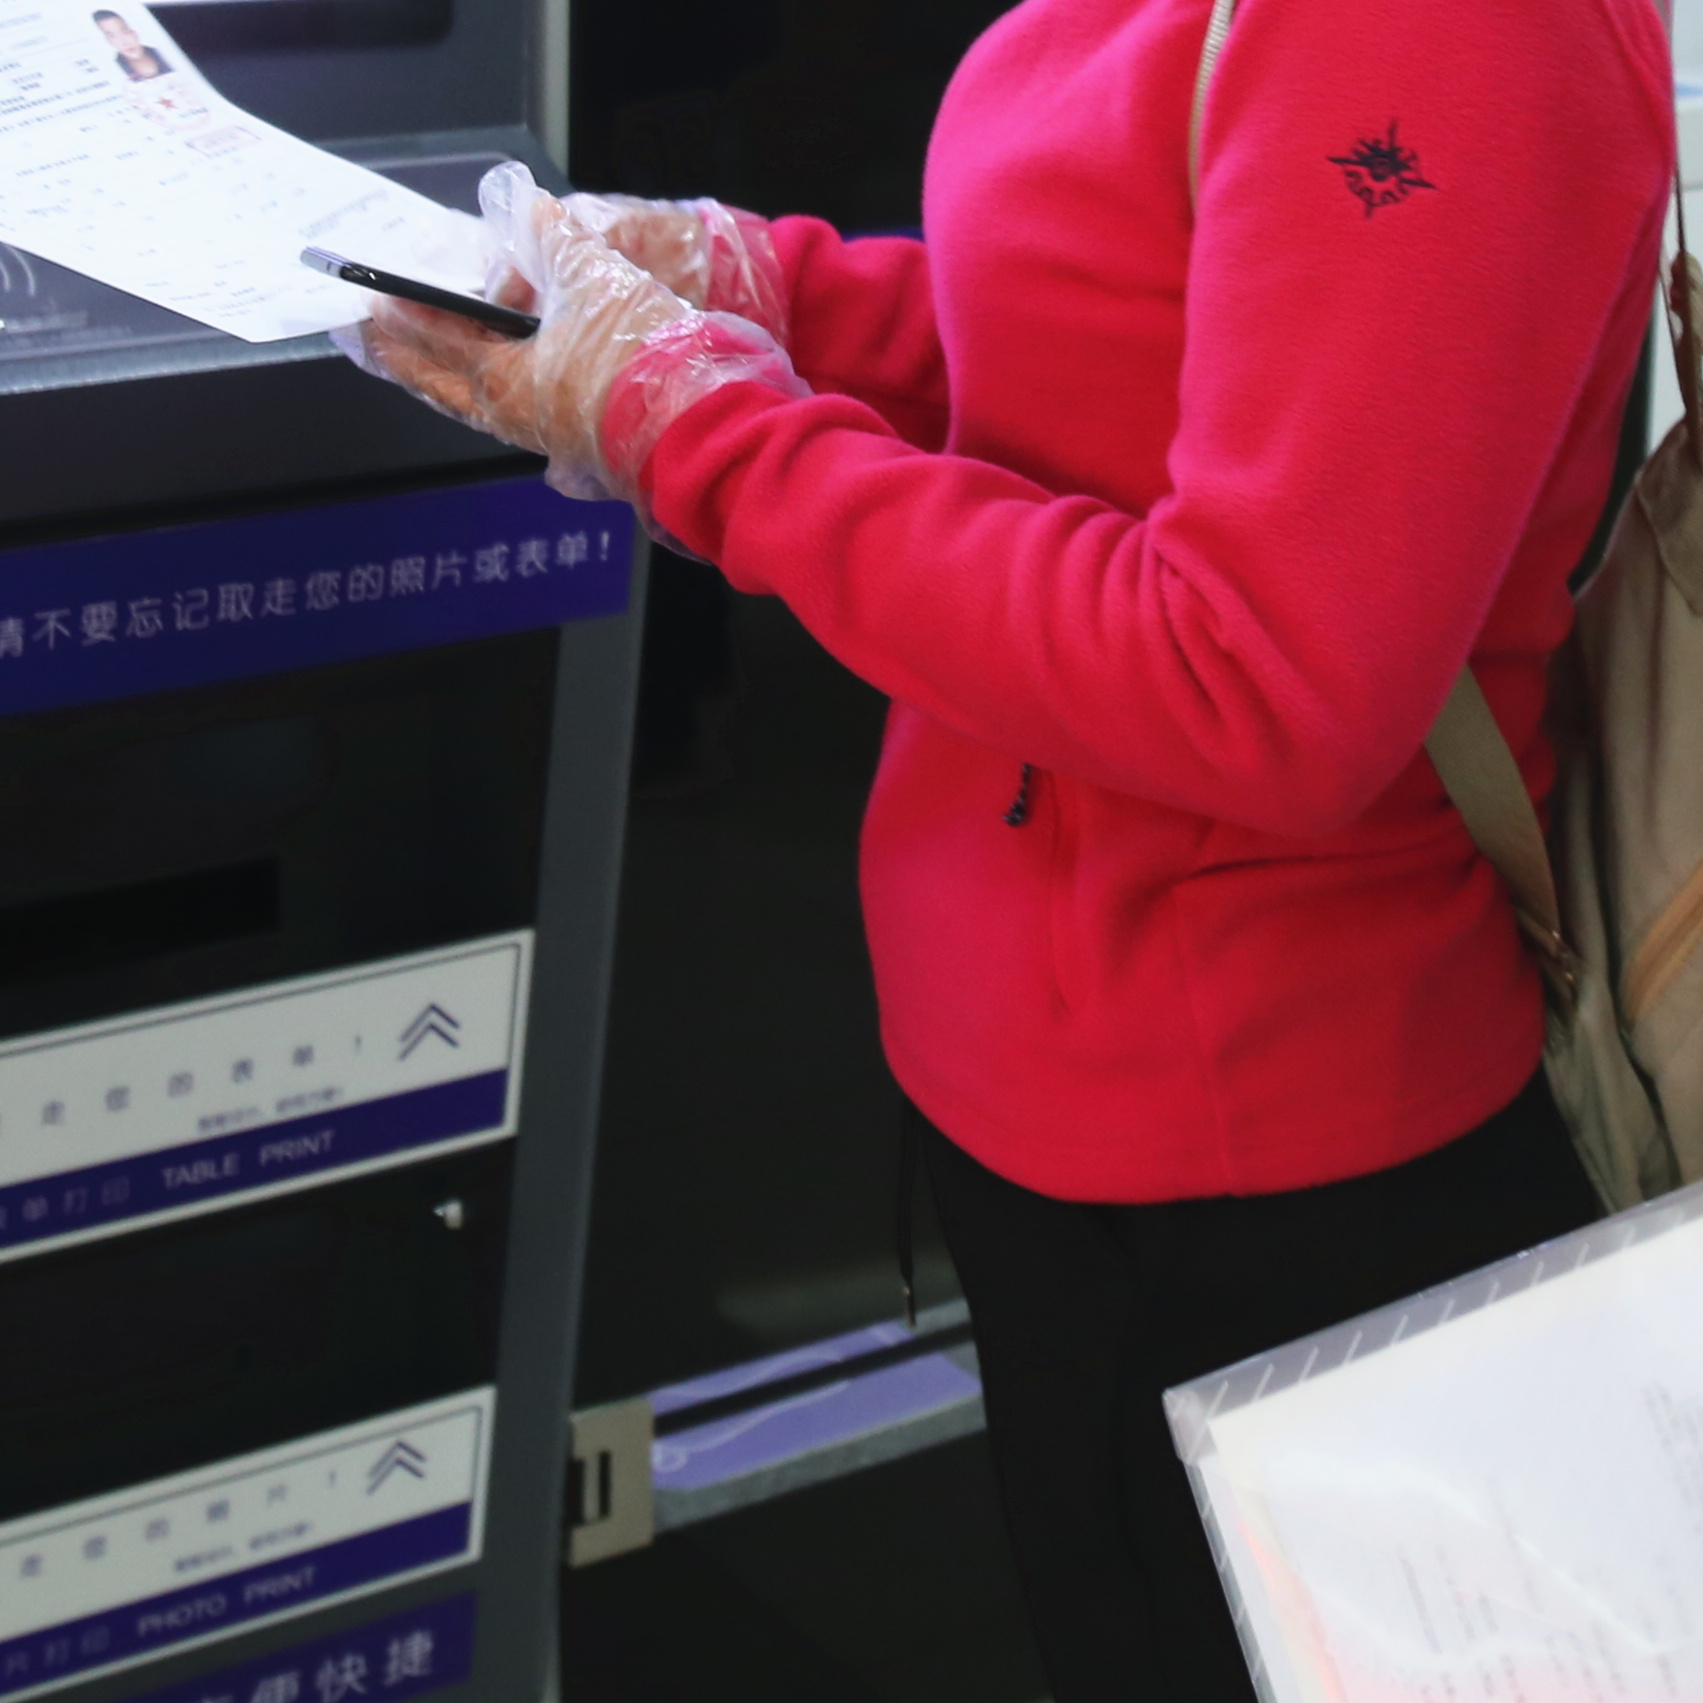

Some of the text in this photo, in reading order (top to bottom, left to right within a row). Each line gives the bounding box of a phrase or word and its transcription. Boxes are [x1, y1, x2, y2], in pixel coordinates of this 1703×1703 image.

[161, 1152, 240, 1193] TABLE
[259, 1130, 336, 1168] PRINT
[136, 1593, 228, 1639] PHOTO
[244, 1564, 318, 1606] PRINT
